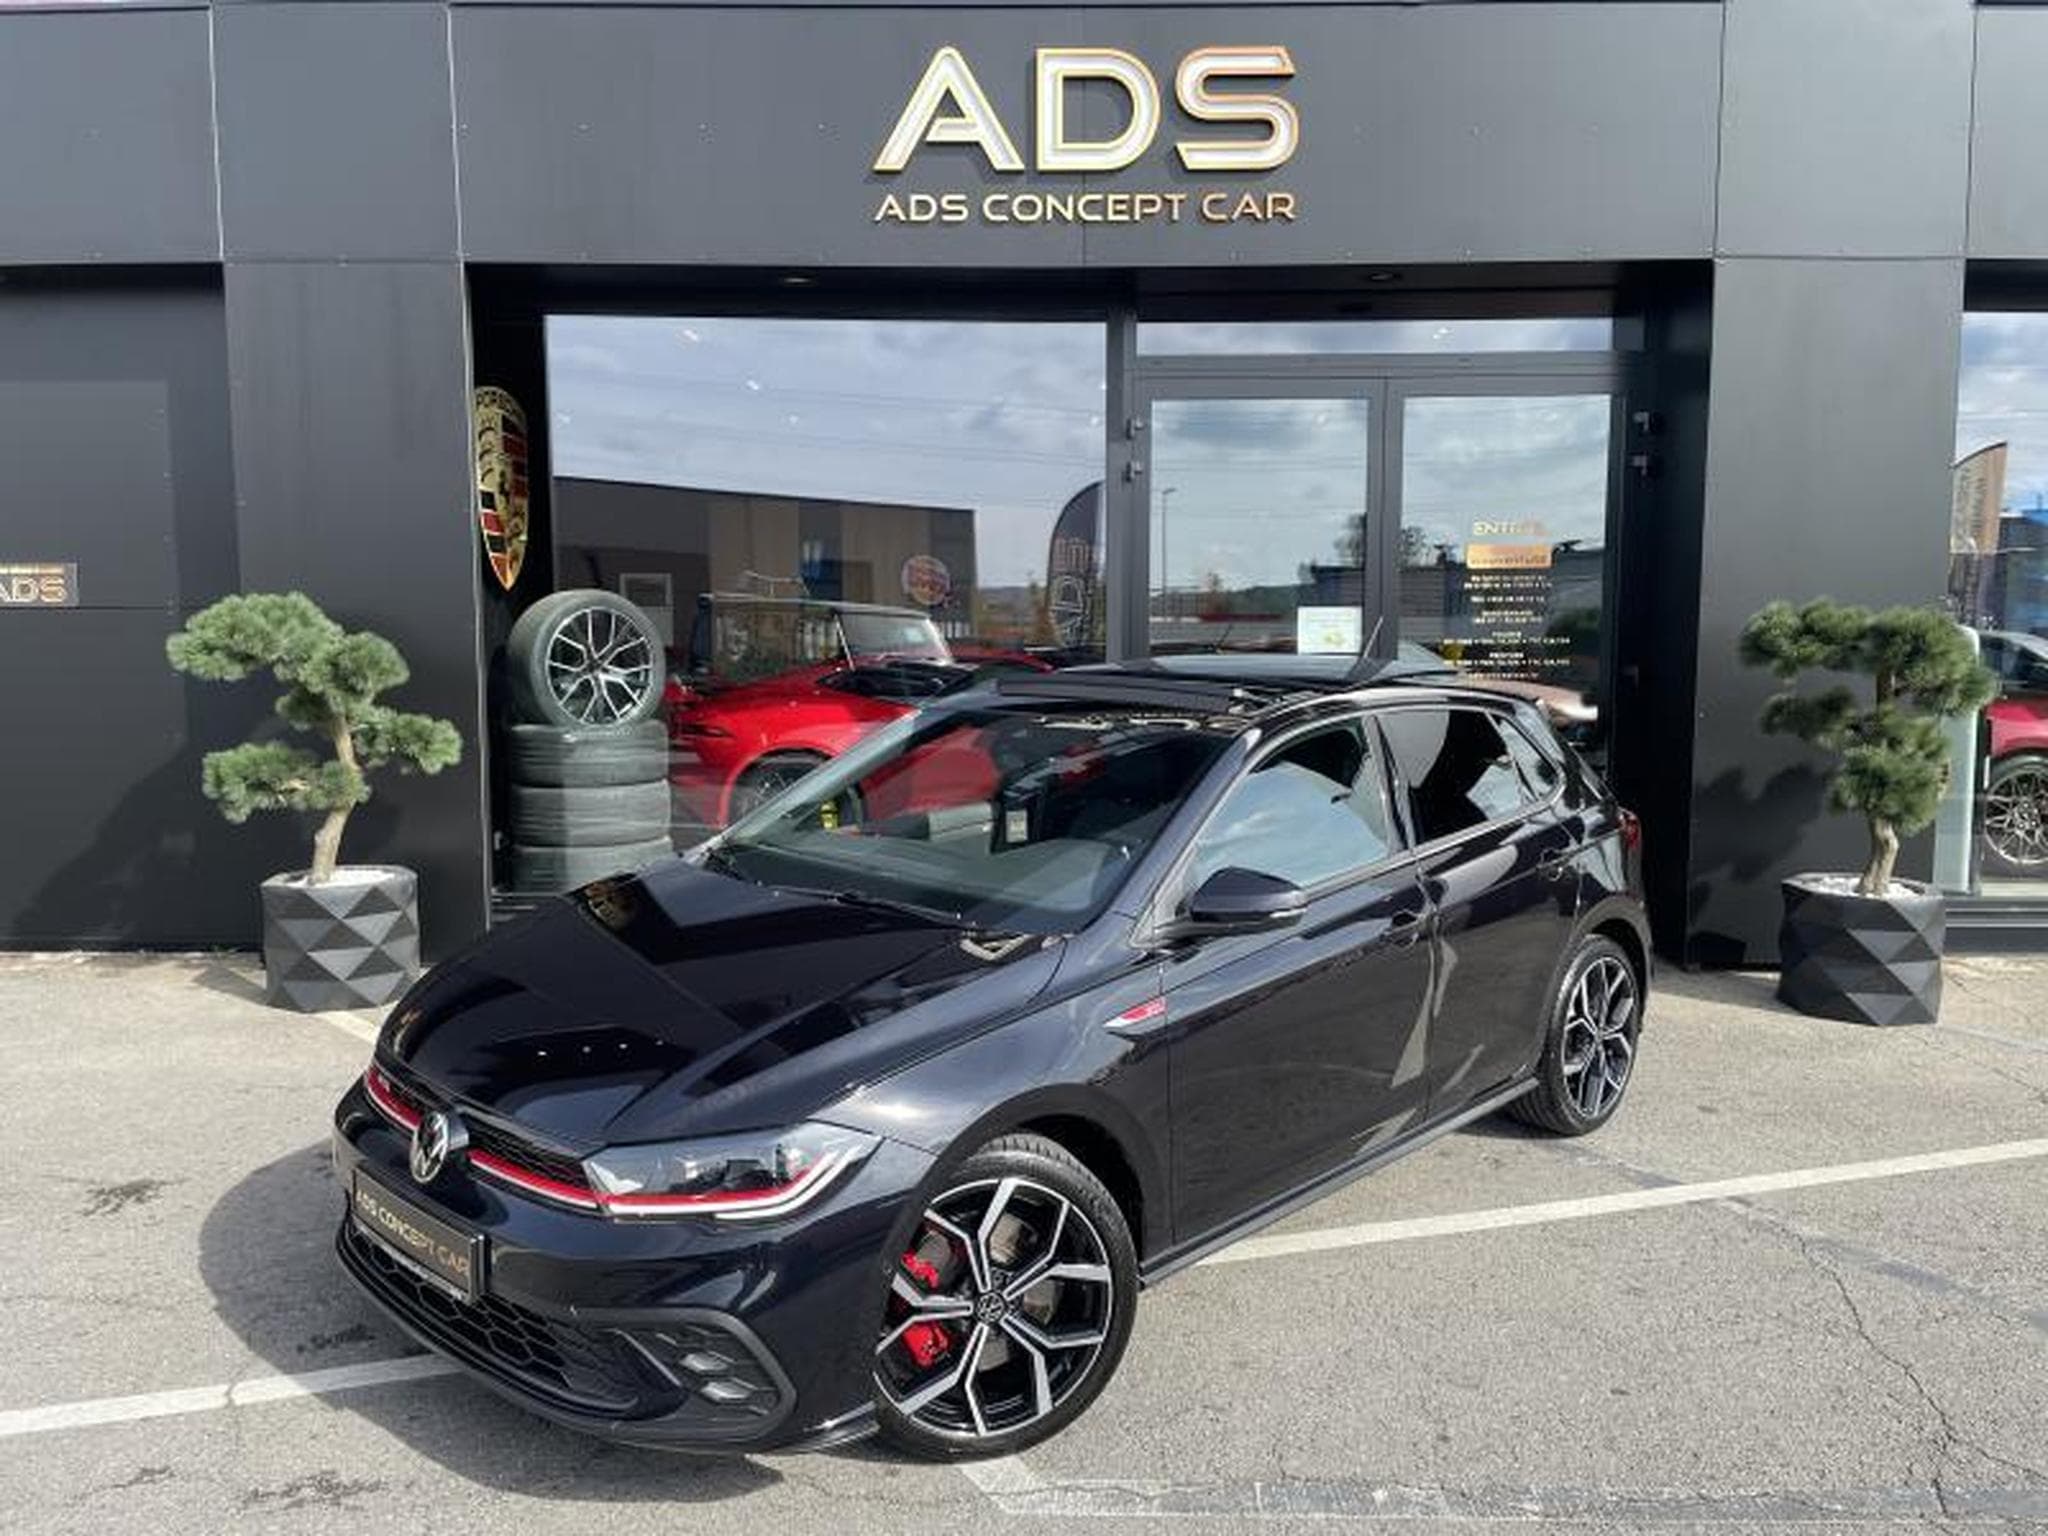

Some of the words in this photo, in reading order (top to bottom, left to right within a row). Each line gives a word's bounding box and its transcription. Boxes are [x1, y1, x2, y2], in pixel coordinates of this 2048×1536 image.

[873, 45, 1300, 172] ADS
[873, 193, 970, 223] ADS
[982, 193, 1187, 223] CONCEPT
[1202, 192, 1297, 222] CAR
